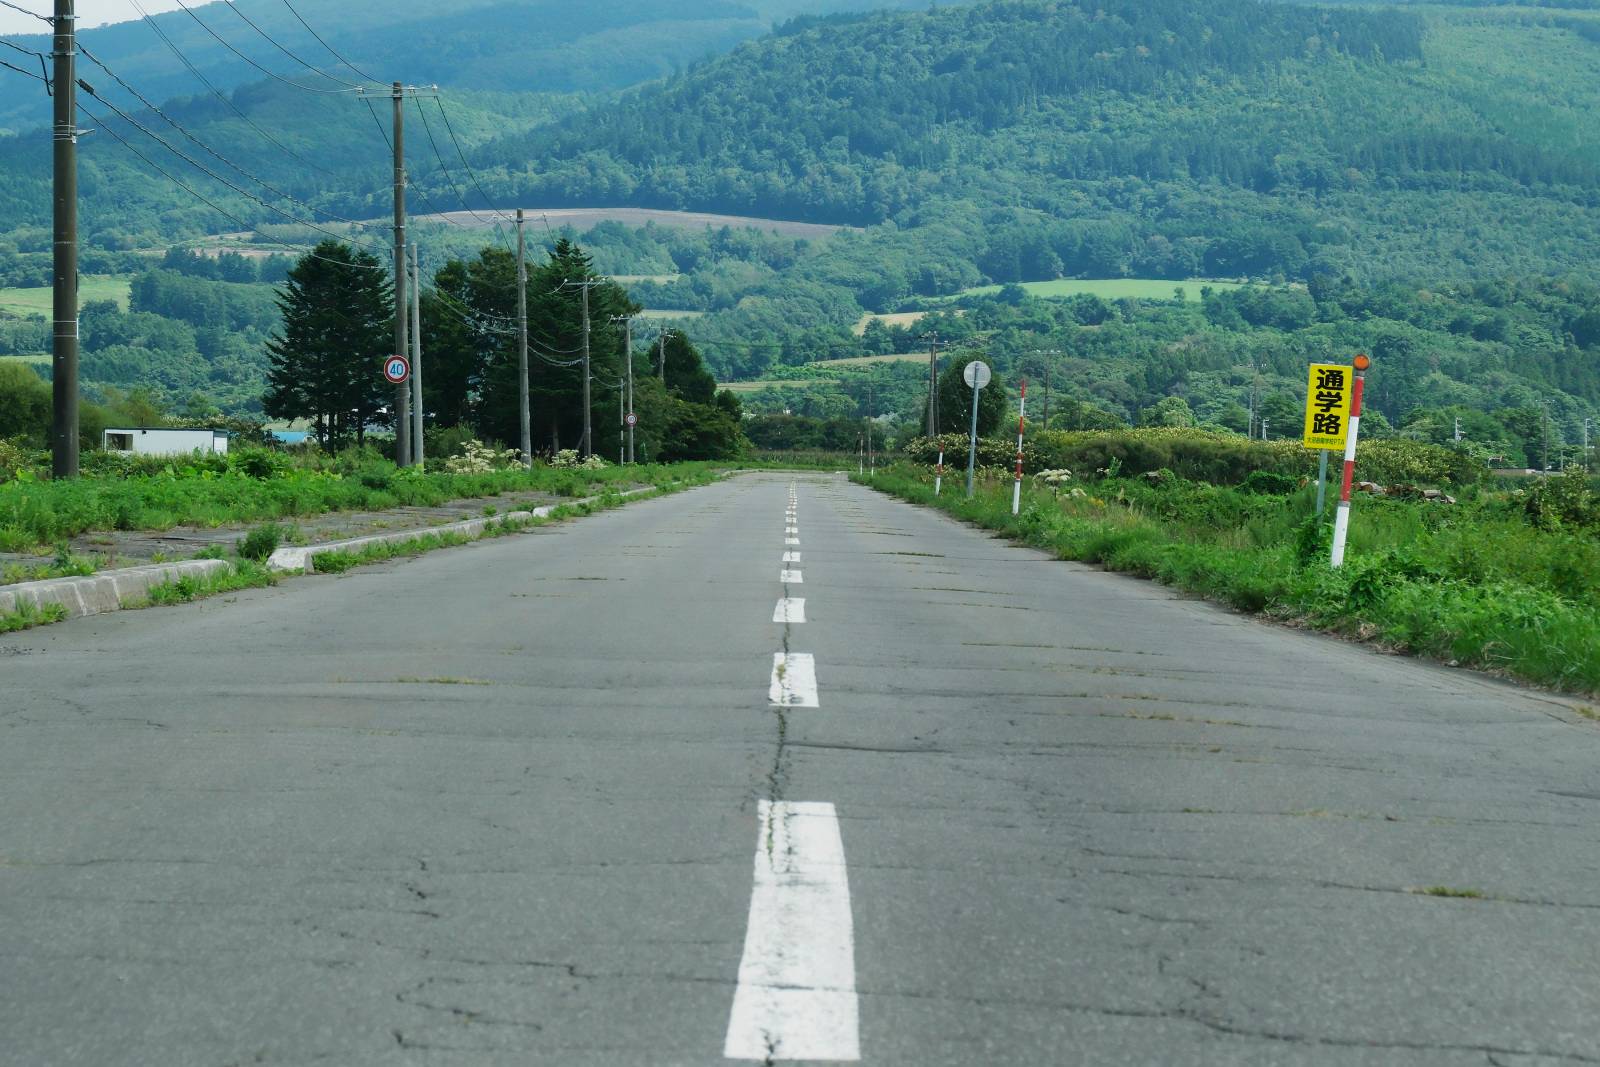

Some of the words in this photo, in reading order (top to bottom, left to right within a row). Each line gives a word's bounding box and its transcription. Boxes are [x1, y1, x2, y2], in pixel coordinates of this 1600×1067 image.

[390, 364, 403, 375] 40
[1312, 368, 1344, 435] 通学路
